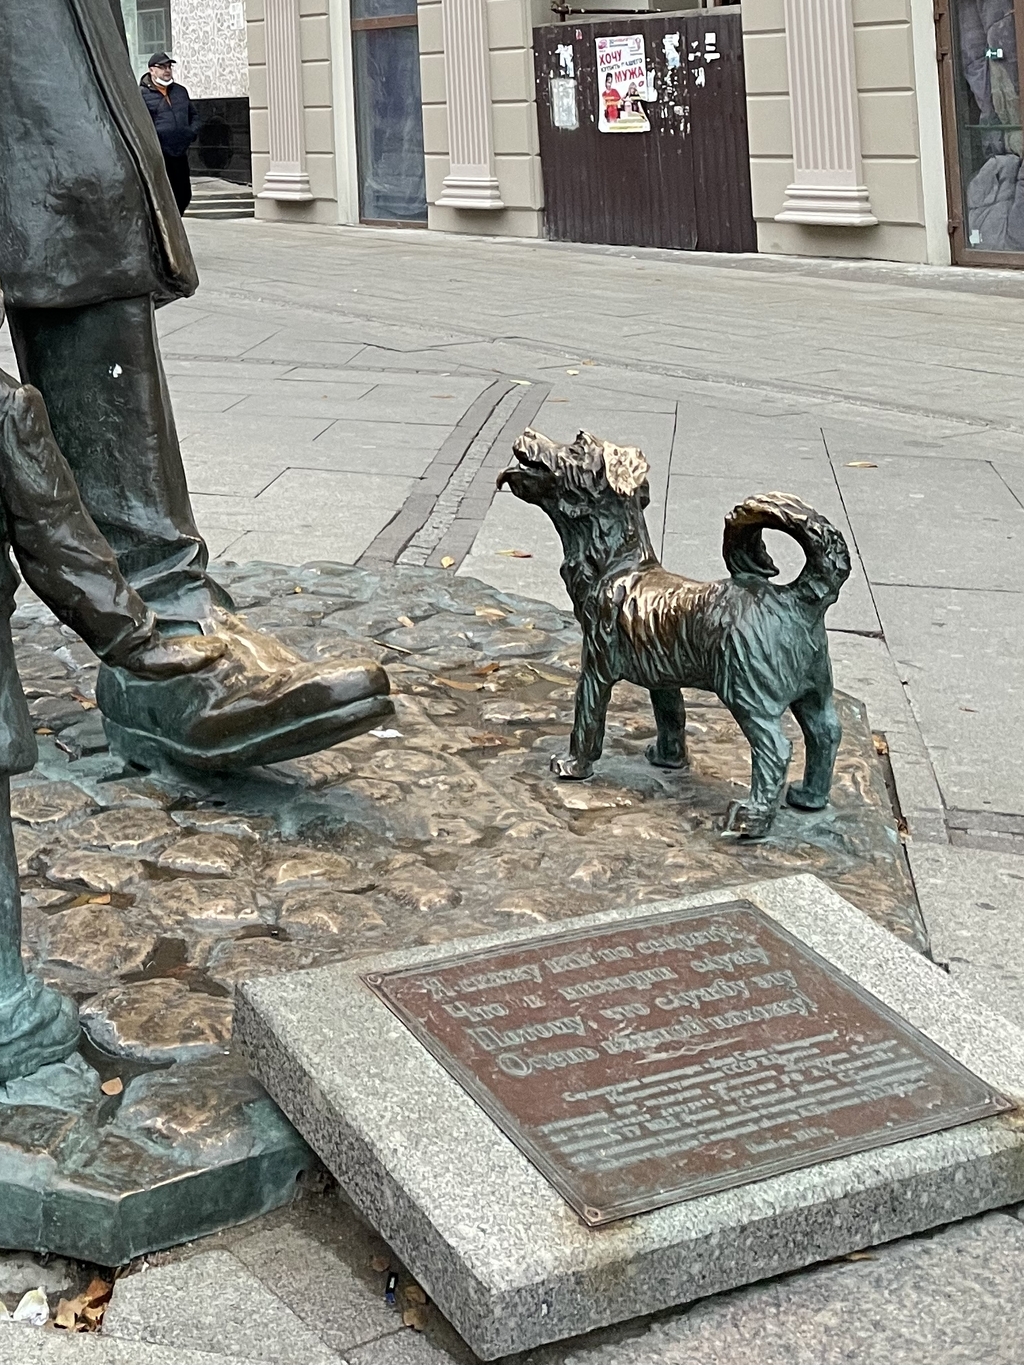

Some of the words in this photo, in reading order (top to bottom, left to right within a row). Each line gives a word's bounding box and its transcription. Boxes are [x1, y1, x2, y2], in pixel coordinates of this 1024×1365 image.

[599, 49, 622, 66] ХОЧУ
[615, 66, 645, 84] МУЖА
[426, 978, 456, 999] Я
[458, 965, 542, 992] скажу
[598, 946, 633, 960] по
[443, 1001, 509, 1023] Что
[559, 967, 678, 1000] милиции
[600, 1003, 650, 1020] что
[654, 979, 750, 1010] службу
[752, 970, 798, 988] эту
[496, 1047, 599, 1076] Очень
